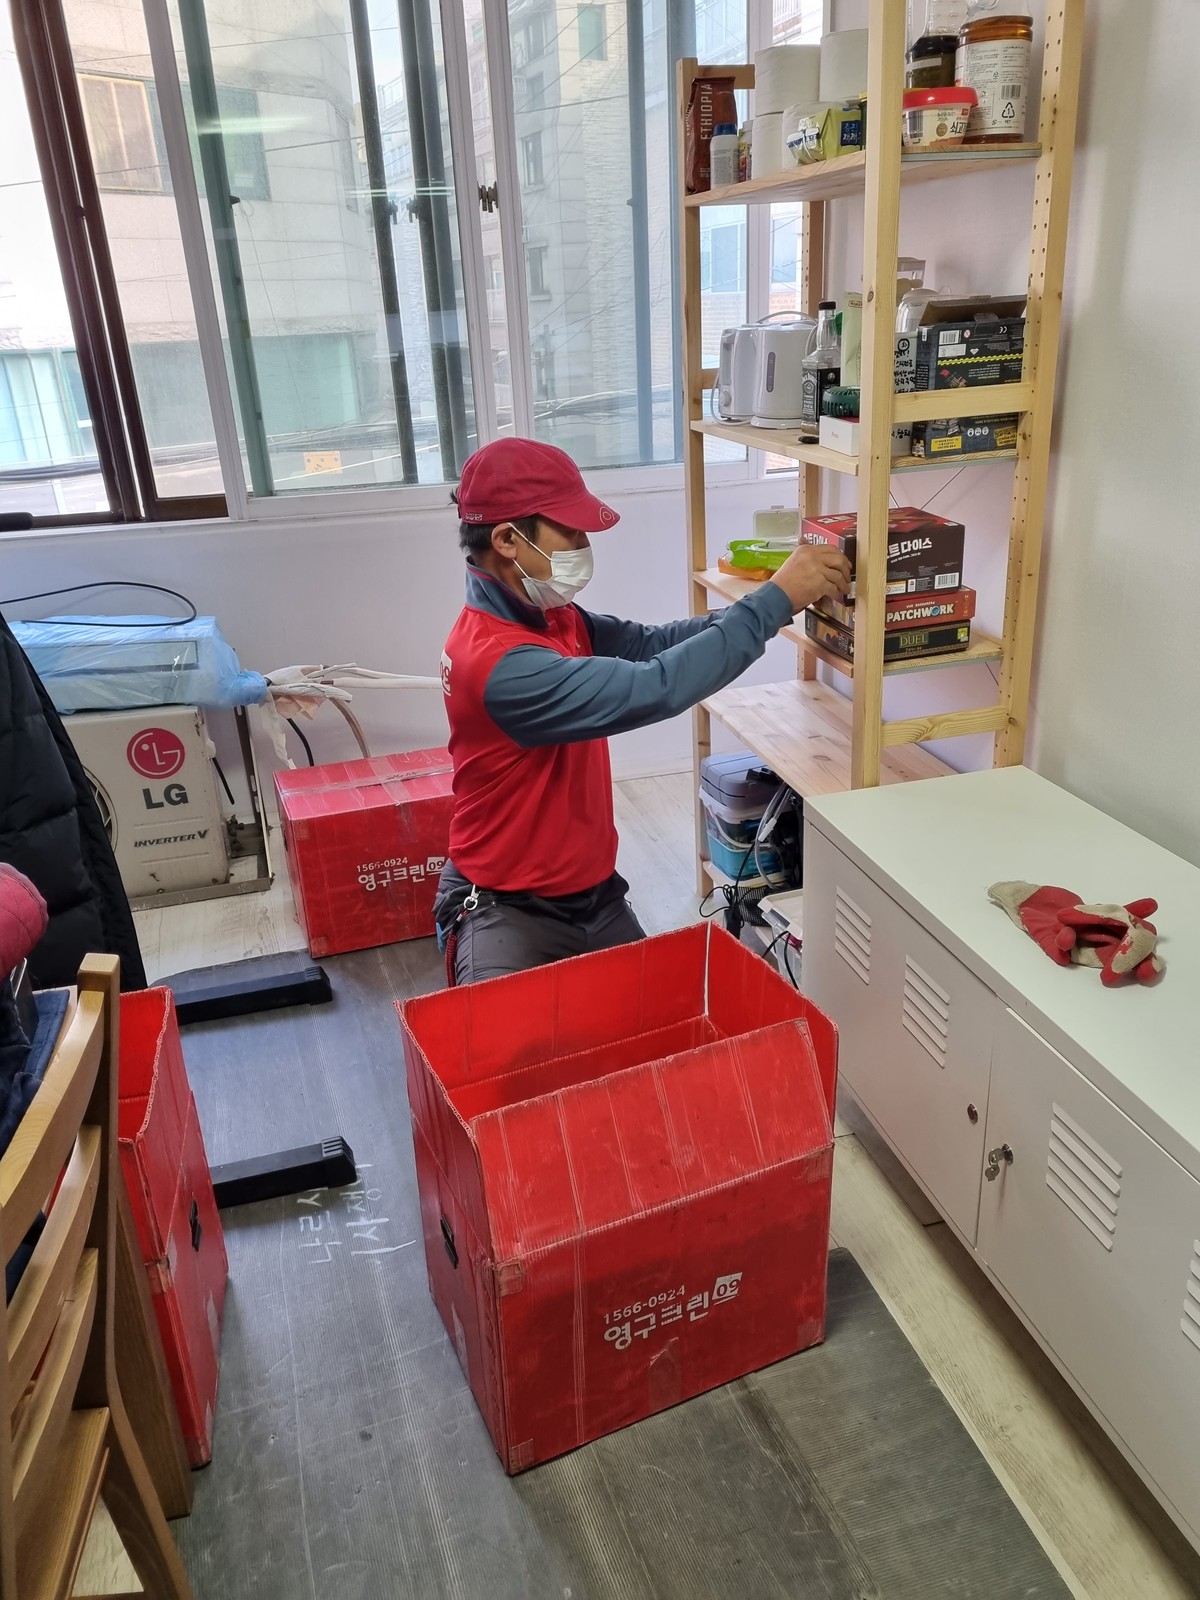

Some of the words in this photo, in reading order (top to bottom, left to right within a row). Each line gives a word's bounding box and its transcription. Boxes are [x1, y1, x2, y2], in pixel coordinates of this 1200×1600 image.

[700, 83, 713, 140] ETHIOPIA
[886, 537, 933, 559] 트다이스
[886, 603, 954, 623] PATCHWORK
[899, 632, 928, 647] DUEL
[142, 782, 189, 810] LG
[134, 834, 196, 848] INVERTER
[356, 856, 408, 873] 1566-0924
[357, 864, 427, 892] 영구크린
[603, 1284, 686, 1325] 1566-0924
[603, 1291, 710, 1350] 영구크린
